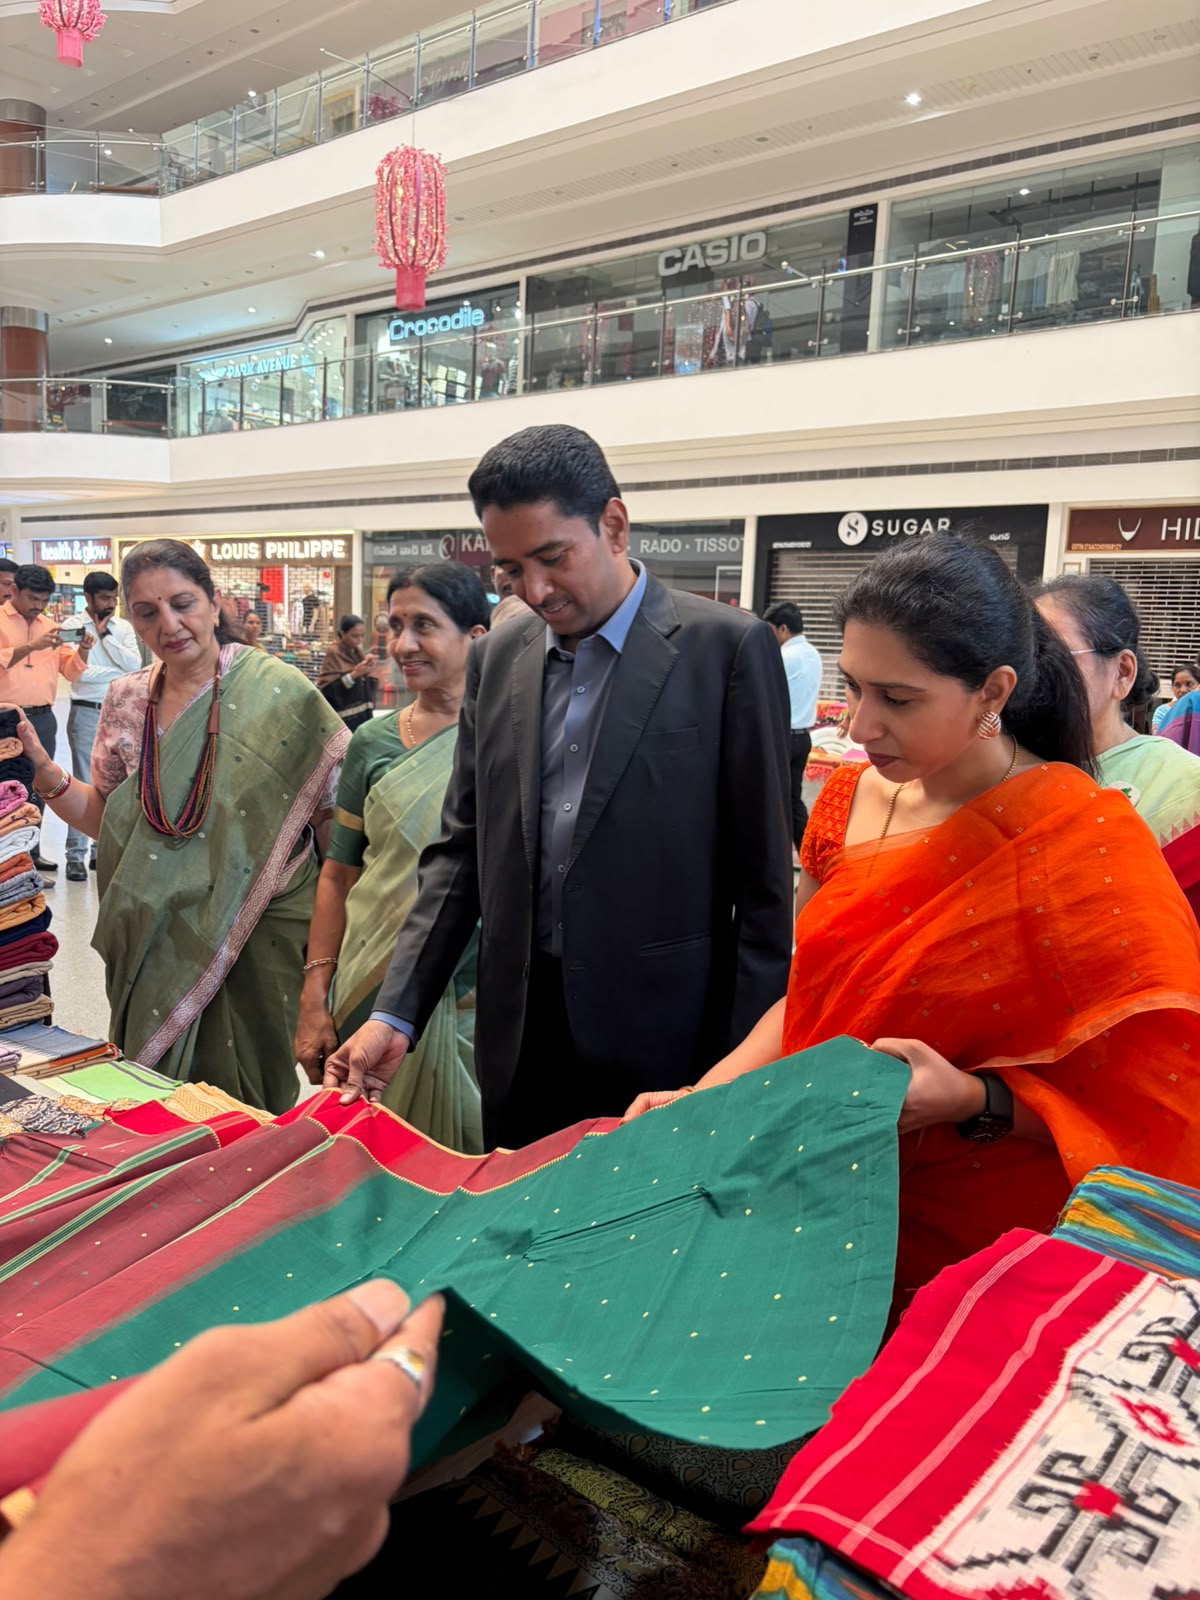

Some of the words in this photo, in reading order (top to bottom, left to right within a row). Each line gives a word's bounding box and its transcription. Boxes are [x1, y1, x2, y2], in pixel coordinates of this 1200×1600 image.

[658, 231, 767, 276] CASIO
[389, 306, 484, 341] Crocodile
[226, 362, 254, 378] PARK
[256, 353, 297, 374] AVENUE
[871, 518, 950, 536] SUGAR
[41, 541, 71, 560] health
[72, 540, 82, 560] &
[82, 540, 107, 564] glow
[212, 542, 259, 560] LOUIS
[265, 539, 345, 560] PHILIPPE
[640, 538, 681, 553] RADO
